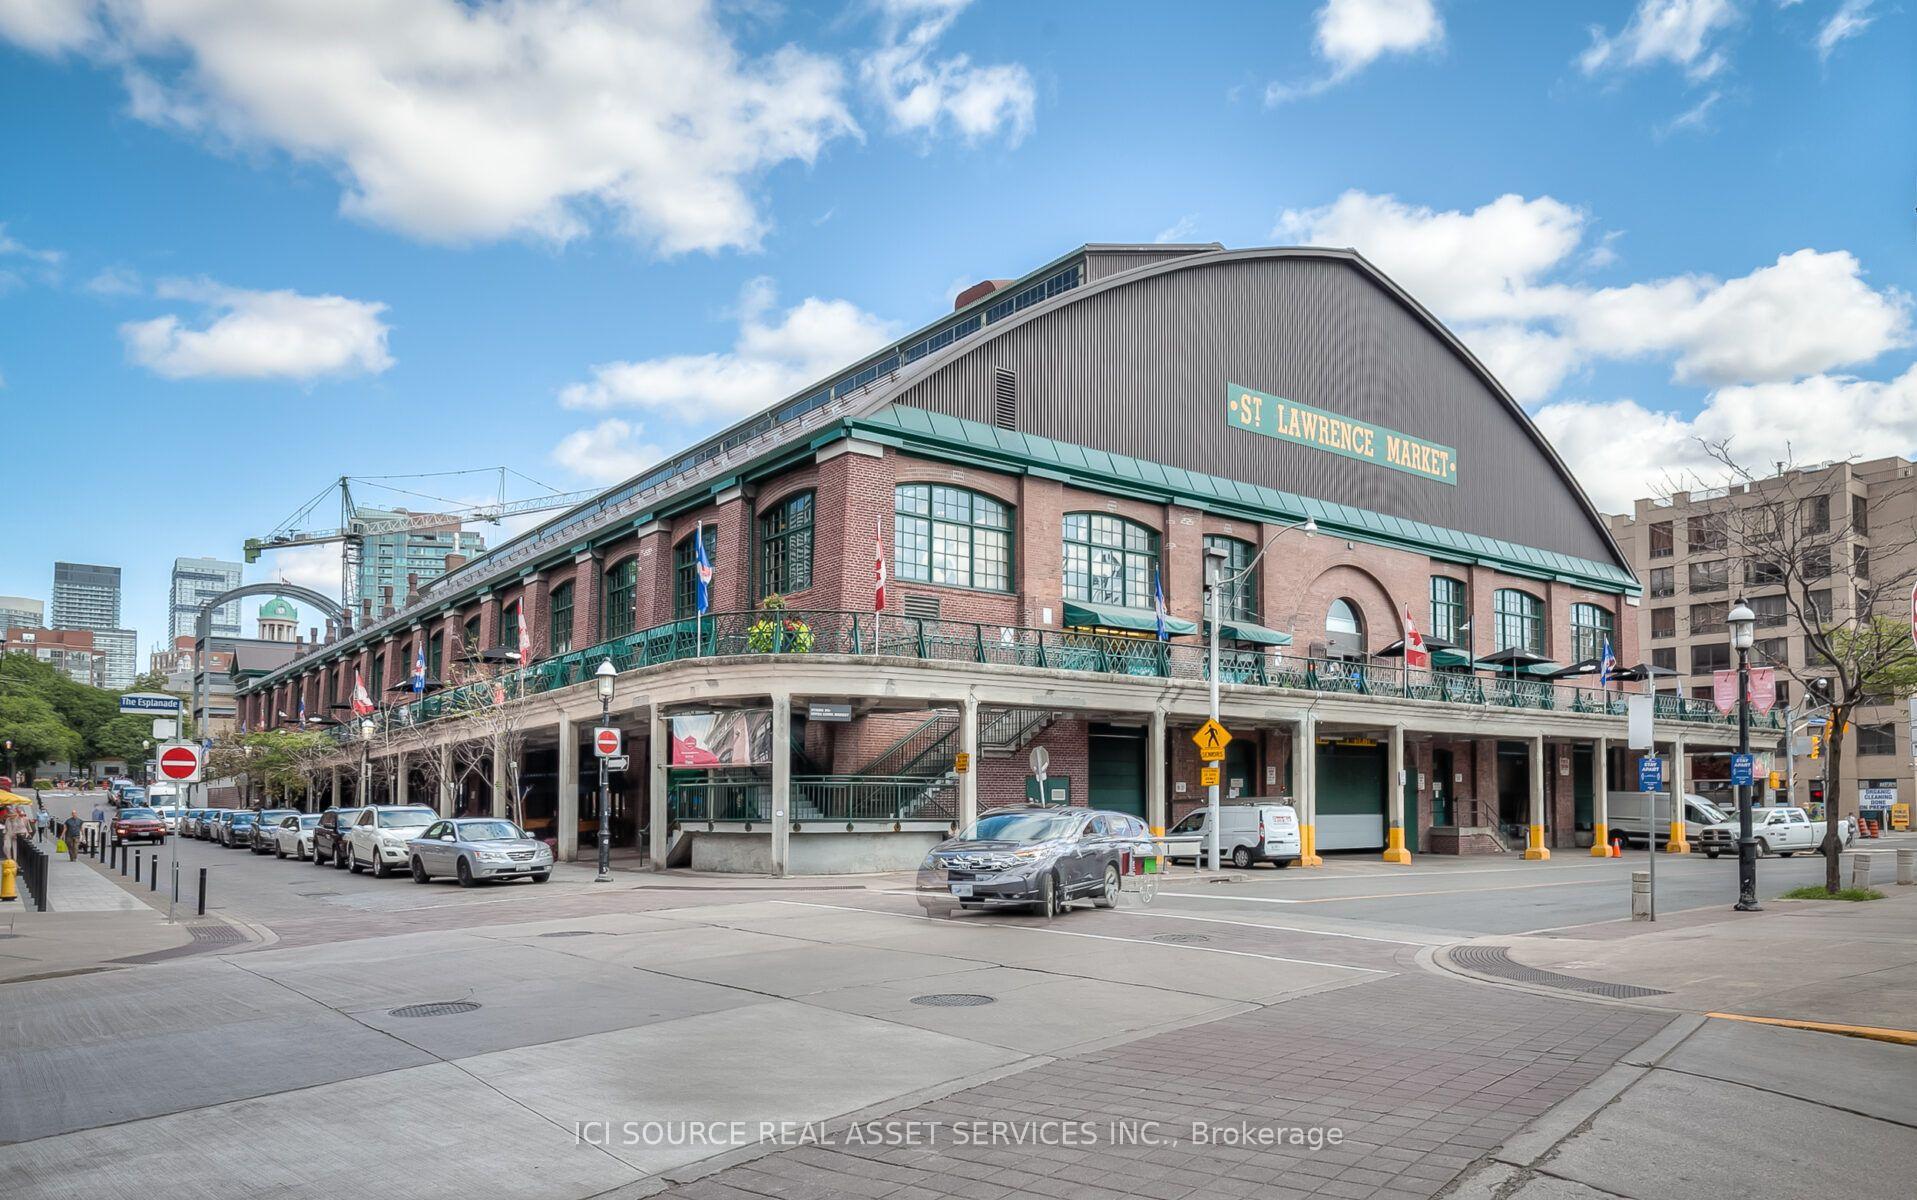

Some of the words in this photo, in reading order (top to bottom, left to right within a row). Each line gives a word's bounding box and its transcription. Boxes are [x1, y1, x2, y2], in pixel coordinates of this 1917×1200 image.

[1277, 404, 1374, 457] LAWRENCE
[1386, 435, 1448, 477] MARKET
[121, 697, 136, 706] The
[137, 698, 178, 708] Esplanade
